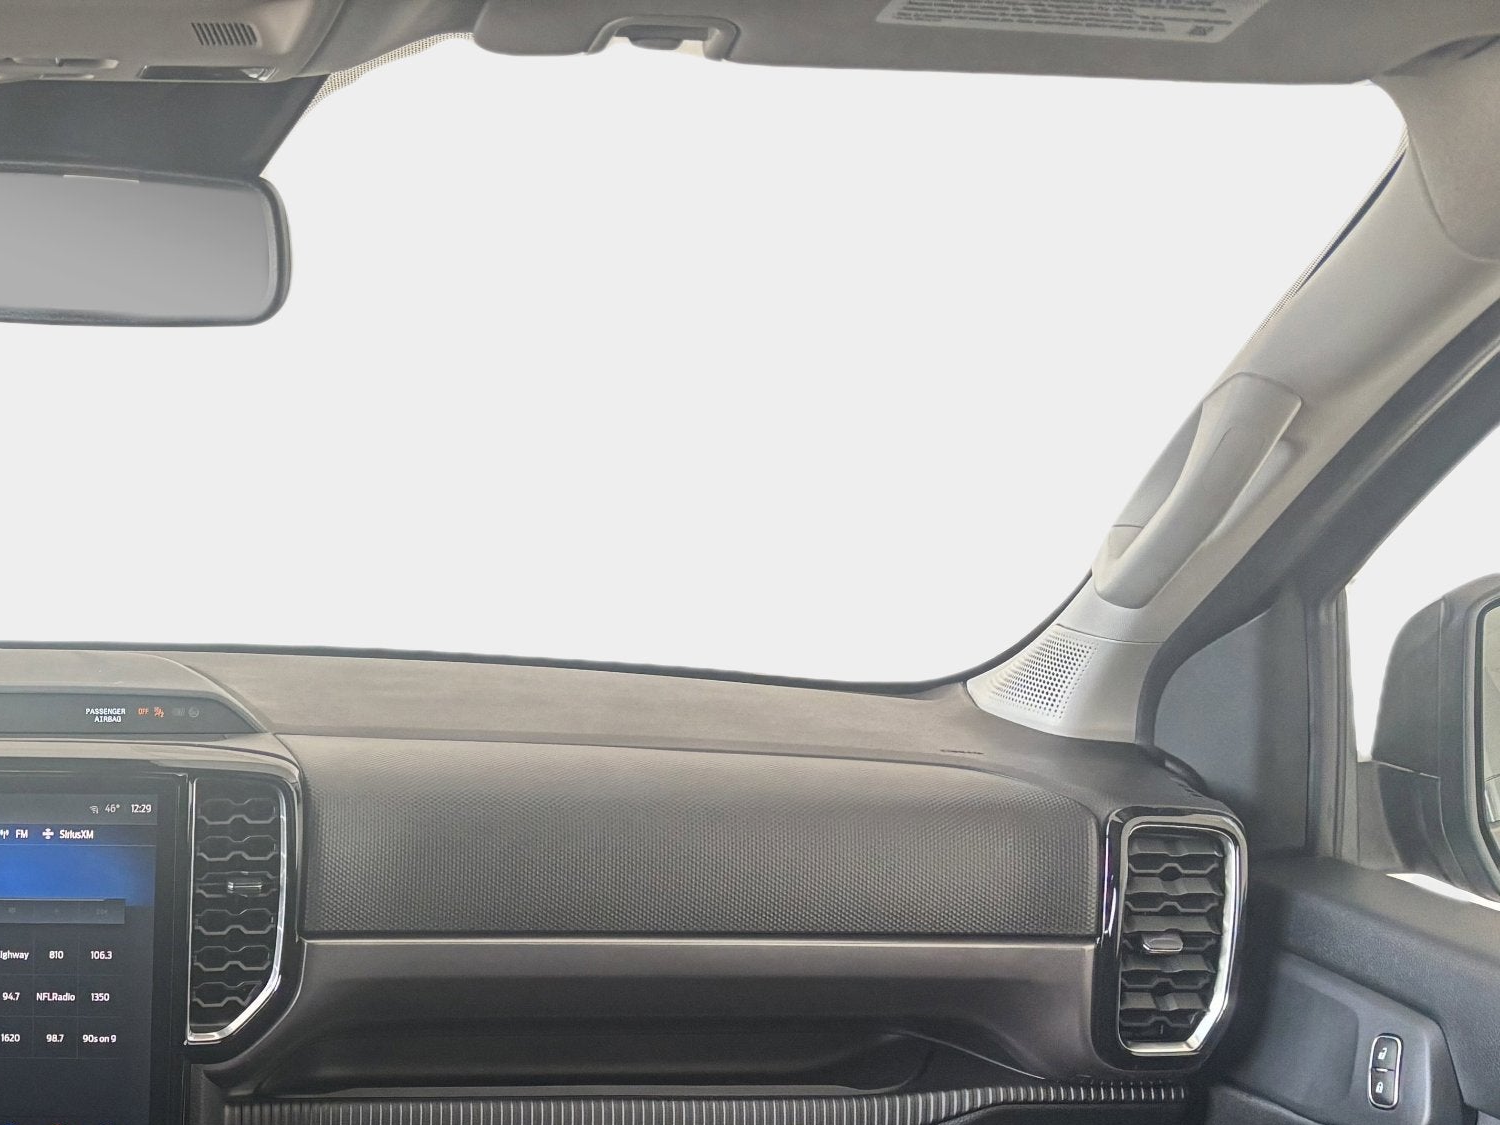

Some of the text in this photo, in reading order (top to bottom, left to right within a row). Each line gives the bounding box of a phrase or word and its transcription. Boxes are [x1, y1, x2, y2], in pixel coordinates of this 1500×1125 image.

[131, 804, 151, 813] 12:29
[16, 829, 28, 838] FM
[60, 830, 93, 839] SiriusXM
[49, 951, 64, 959] 810
[91, 951, 112, 959] 106.3
[3, 992, 20, 1001] 94.7
[36, 993, 75, 1001] NFLRadio
[91, 993, 110, 1001] 1350
[1, 1034, 20, 1042] 1620
[46, 1034, 64, 1042] 98.7
[83, 1034, 98, 1042] 90s
[111, 1035, 116, 1043] 9
